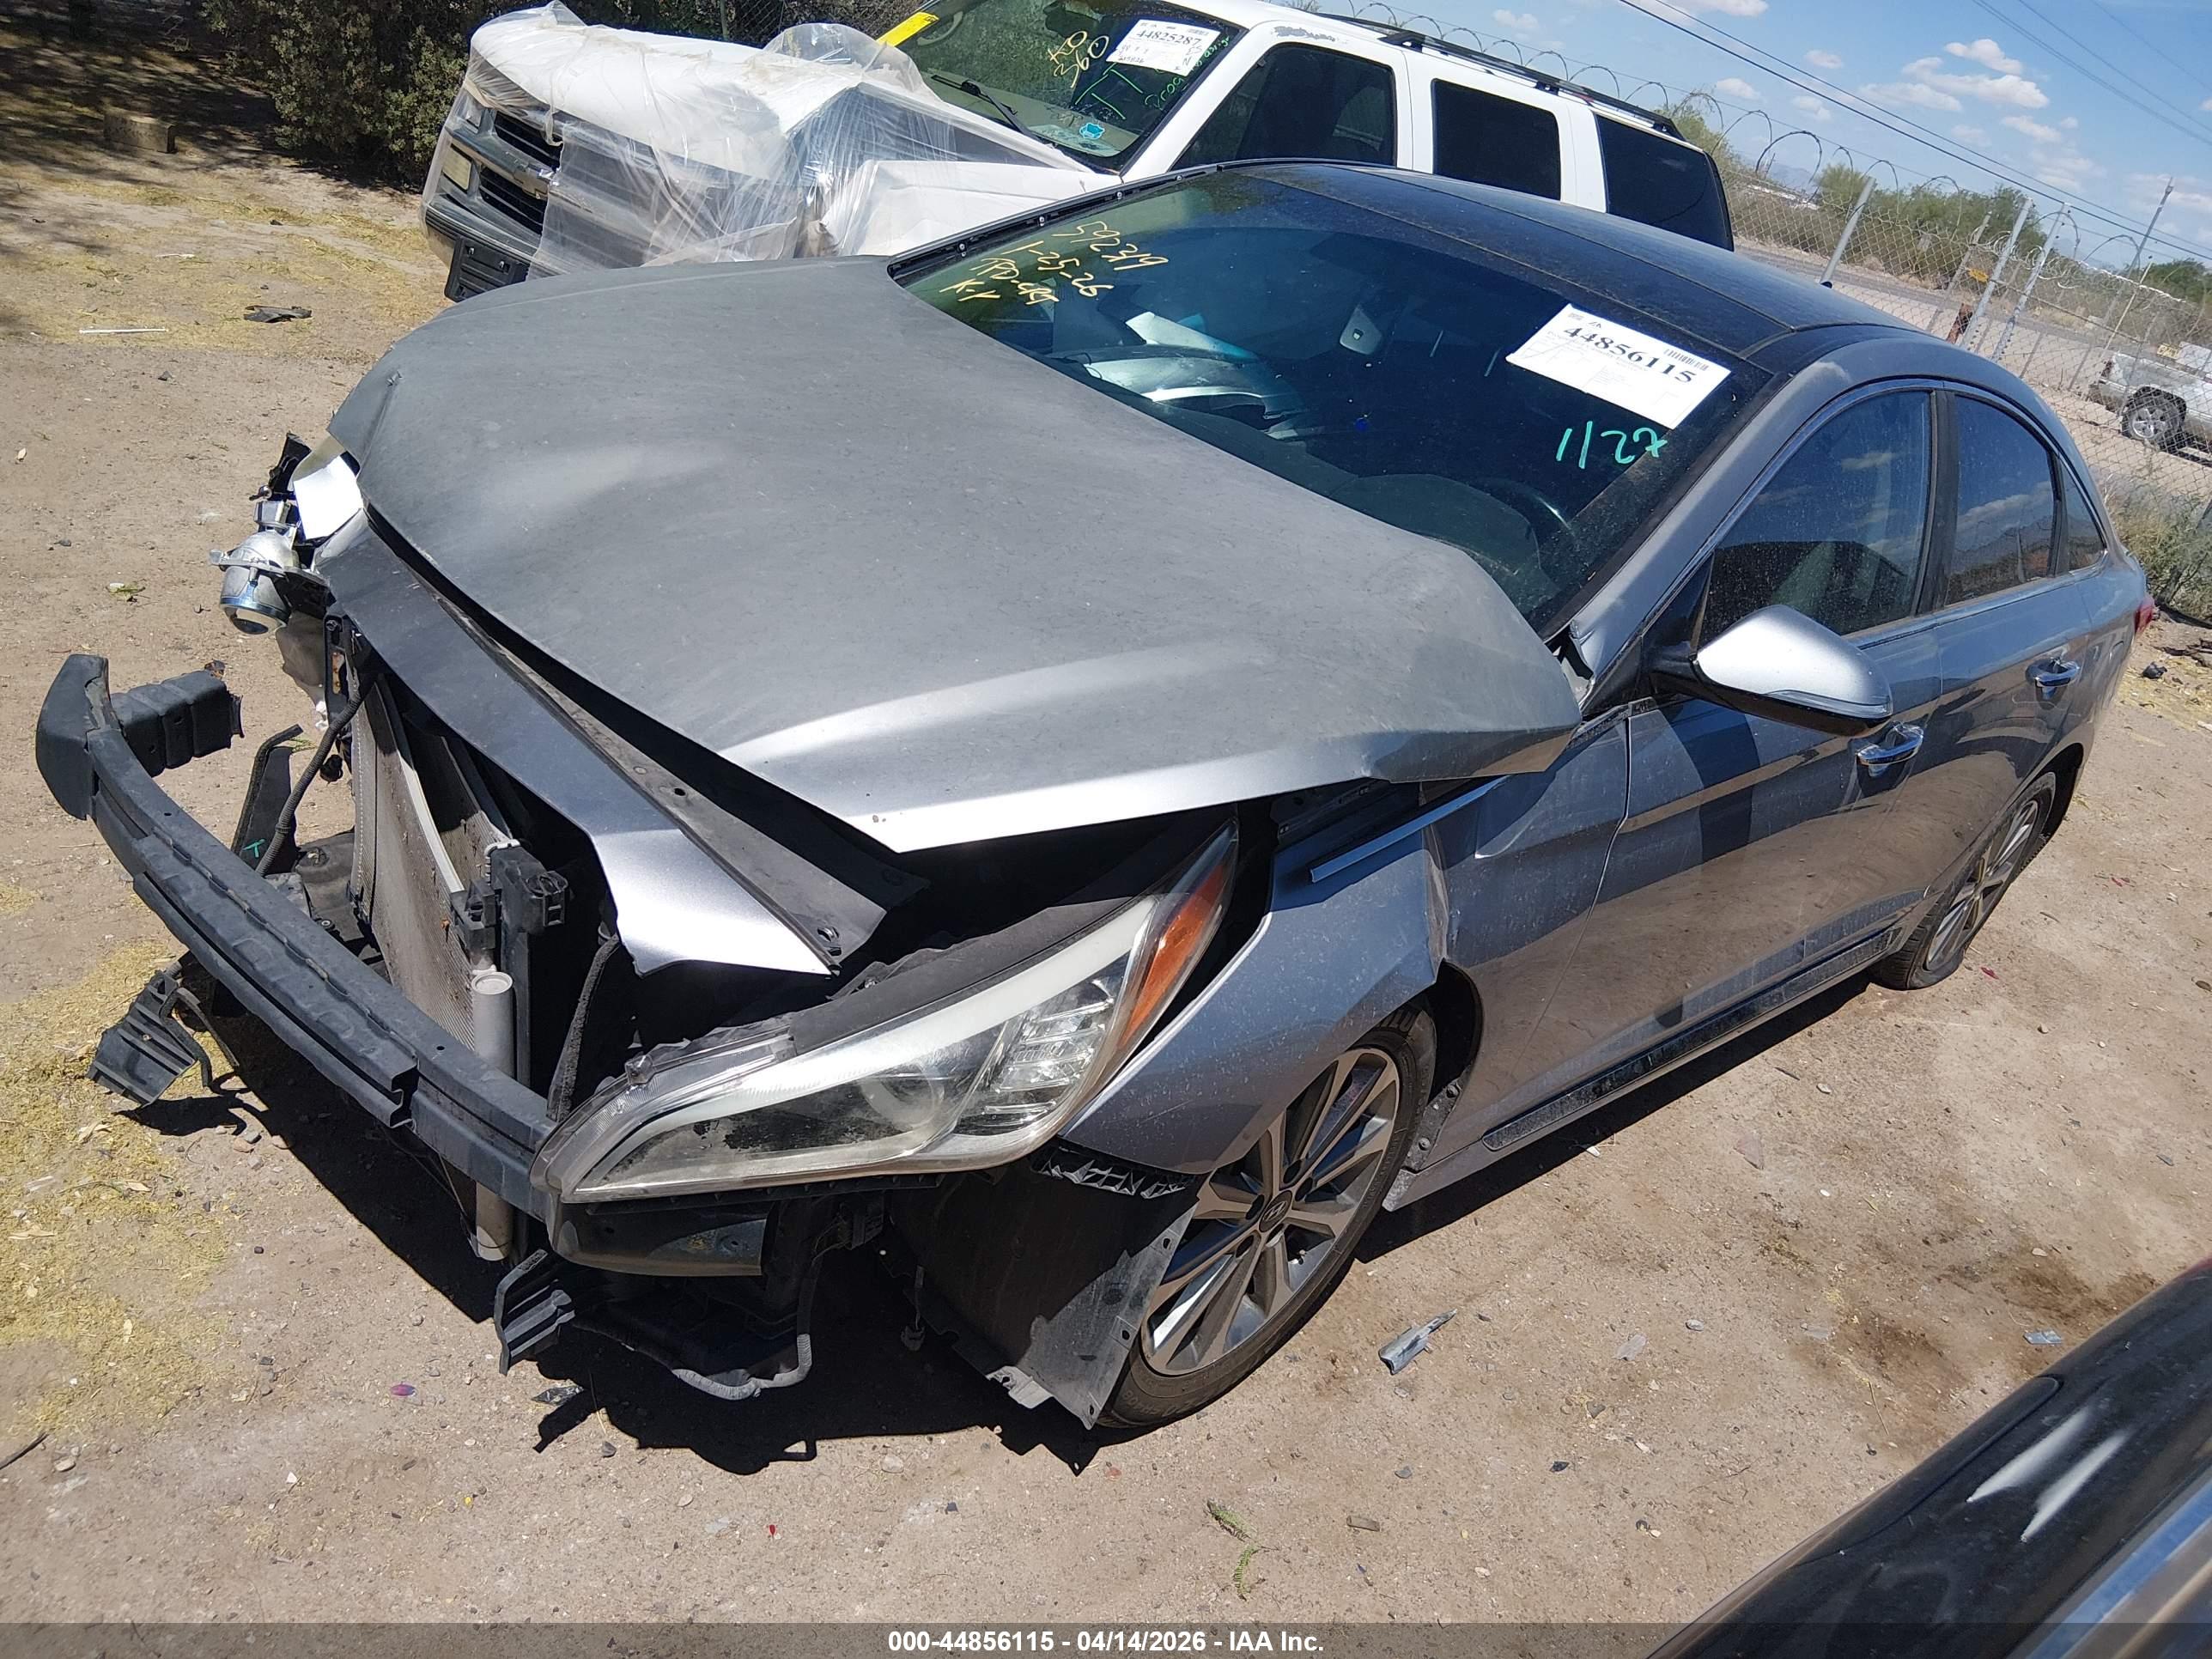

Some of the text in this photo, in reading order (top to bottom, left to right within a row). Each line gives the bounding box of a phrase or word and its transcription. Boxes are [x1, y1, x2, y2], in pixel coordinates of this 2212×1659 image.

[1054, 35, 1109, 88] 360
[1135, 29, 1201, 46] 44825287
[1001, 240, 1114, 297] 1-25-26
[1563, 327, 1698, 384] 44856115
[1555, 421, 1668, 469] 1/27
